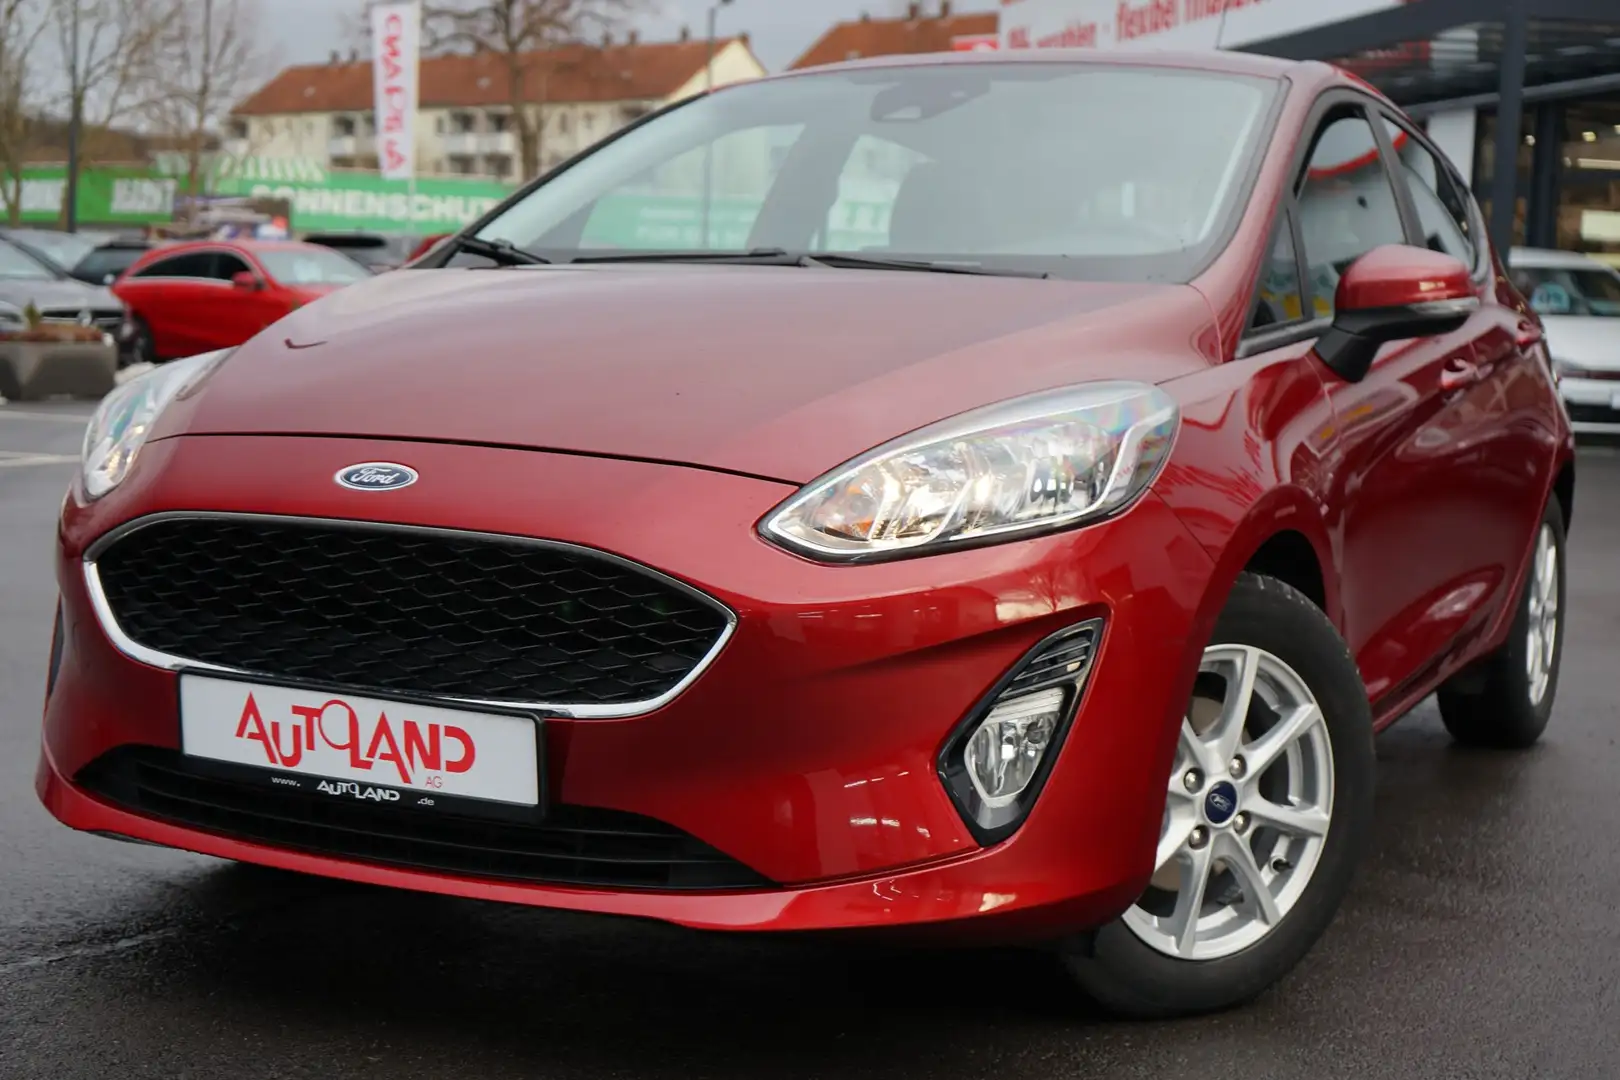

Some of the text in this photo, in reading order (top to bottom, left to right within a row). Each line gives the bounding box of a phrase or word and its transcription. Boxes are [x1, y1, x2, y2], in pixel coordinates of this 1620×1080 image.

[235, 692, 476, 784] AUTOLAND
[271, 777, 435, 806] www. AUTOLAND .de
[425, 775, 443, 789] AG
